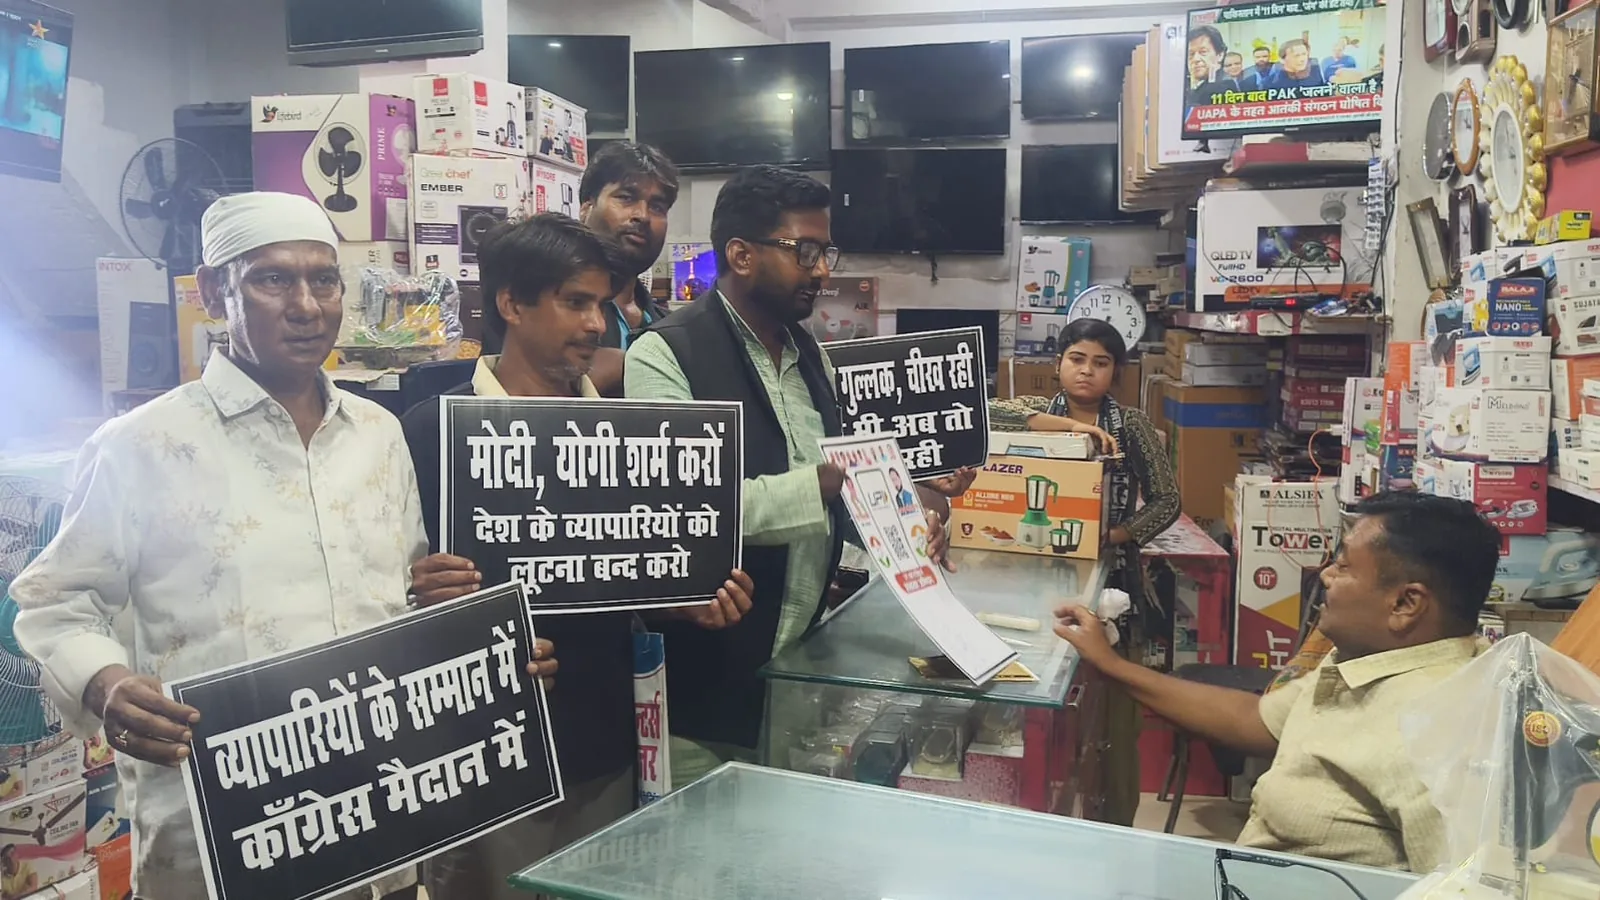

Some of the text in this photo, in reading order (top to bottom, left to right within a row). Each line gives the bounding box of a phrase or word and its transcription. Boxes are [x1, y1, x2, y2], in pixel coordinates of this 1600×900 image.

[1210, 94, 1223, 105] 11
[1225, 90, 1245, 104] दिन
[1247, 90, 1268, 103] बाद
[1268, 87, 1297, 101] PAK
[1336, 83, 1368, 95] वाला
[1368, 80, 1378, 94] है
[1197, 108, 1227, 120] UAPA
[1230, 105, 1242, 118] के
[1243, 105, 1265, 117] तहत
[1268, 101, 1301, 115] आतंकी
[1304, 98, 1337, 113] संगठन
[1339, 97, 1371, 111] घोषित
[377, 127, 386, 161] PRIME
[420, 183, 464, 193] EMBER
[1211, 250, 1252, 261] QLED TV
[98, 262, 132, 272] INTOX
[1218, 263, 1246, 271] FullHD
[1501, 286, 1536, 294] BALAJI
[1090, 298, 1099, 308] 11
[1101, 294, 1112, 304] 12
[1117, 296, 1122, 307] 1
[1080, 307, 1091, 317] 10
[1126, 305, 1133, 315] 2
[1495, 302, 1522, 312] NANO
[1130, 317, 1138, 327] 3
[1126, 330, 1133, 339] 4
[838, 341, 974, 416] गुल्लक, चीख रही
[891, 410, 939, 438] अब
[940, 402, 974, 432] तो
[466, 420, 725, 501] मोदी, योगी शर्म करों
[982, 463, 1024, 475] LAZER
[472, 503, 720, 543] देश के व्यापारियों को
[1252, 526, 1333, 549] Tower
[507, 544, 692, 595] लूटना बन्द करो
[205, 619, 523, 790] व्यापारियों के सम्मान में
[377, 738, 490, 816] मैदान
[490, 709, 529, 771] में
